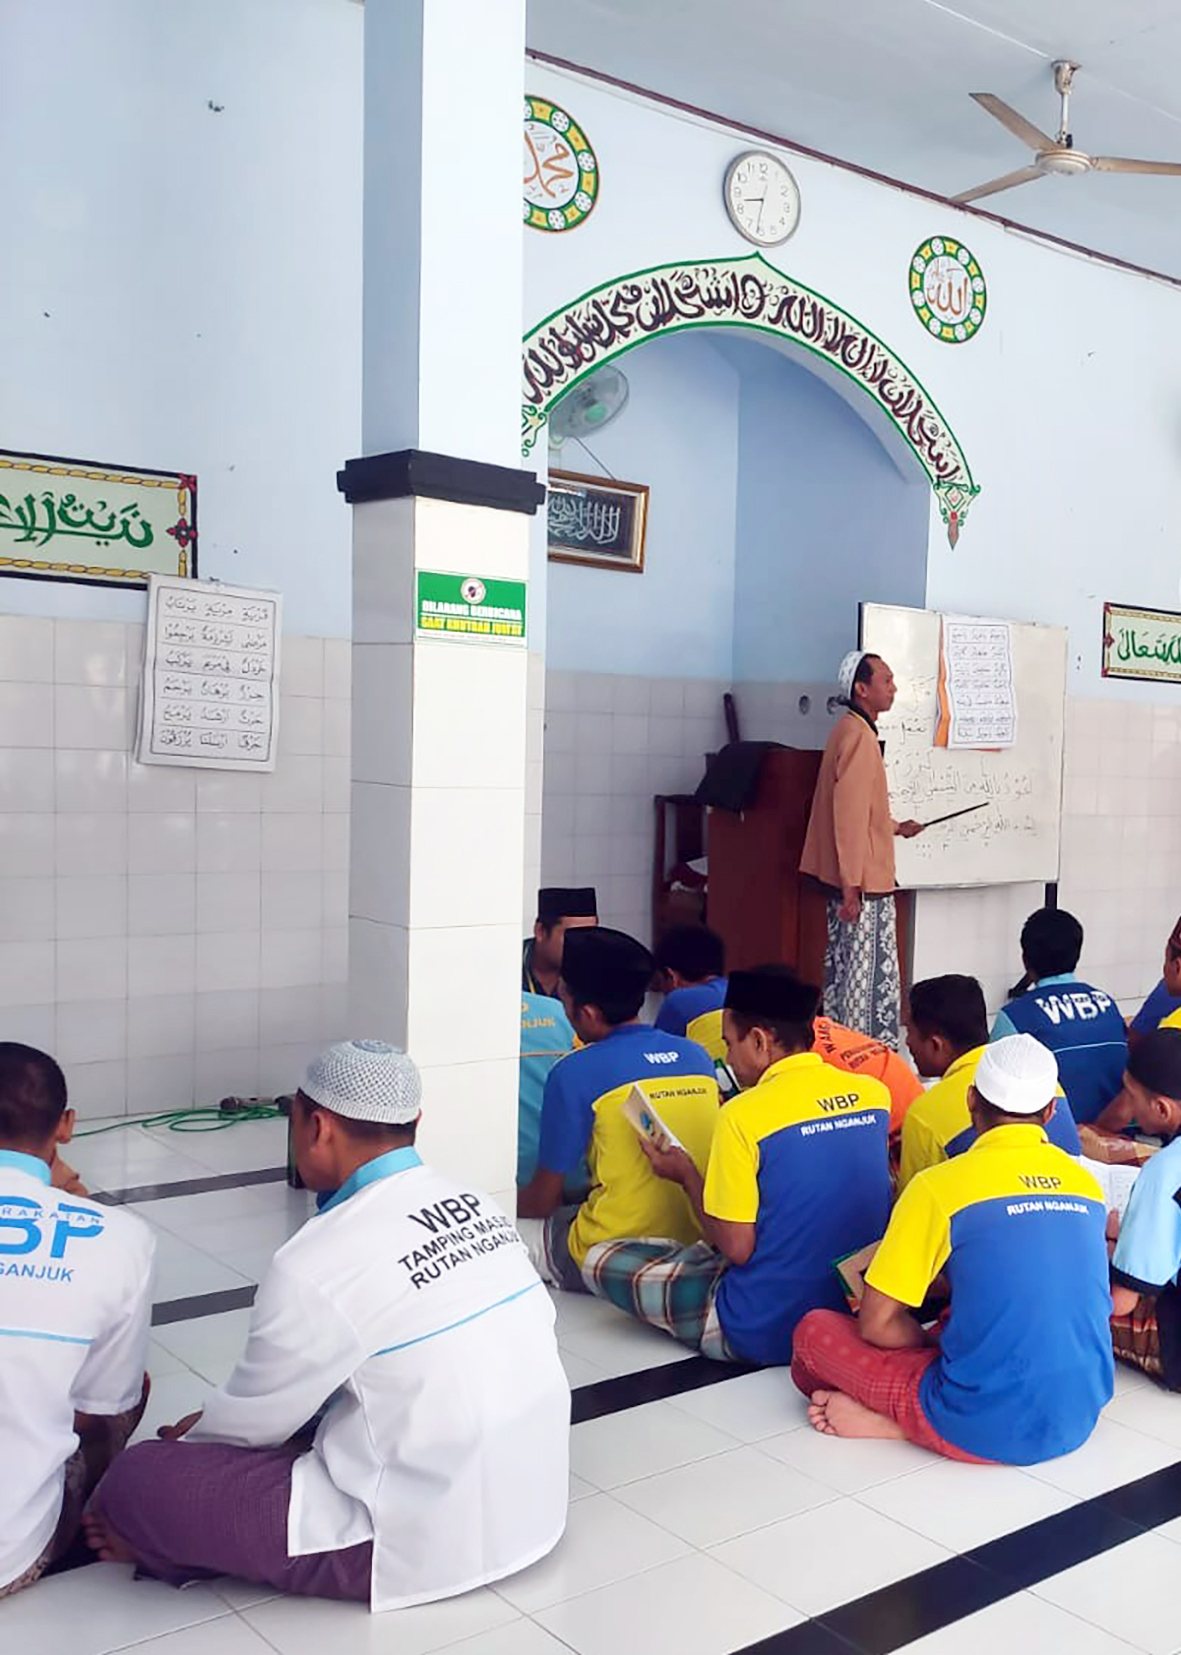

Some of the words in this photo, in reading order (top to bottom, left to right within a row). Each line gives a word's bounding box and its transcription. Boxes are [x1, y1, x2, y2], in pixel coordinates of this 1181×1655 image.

[759, 162, 769, 174] 12
[737, 172, 748, 184] 10
[780, 185, 789, 198] 2
[736, 203, 745, 215] 8
[783, 202, 791, 214] 3
[746, 217, 753, 229] 7
[1035, 990, 1112, 1025] WBP
[643, 1051, 680, 1064] WBP
[816, 1093, 860, 1112] WBP
[800, 1121, 834, 1137] RUTAN
[834, 1114, 876, 1129] NGANJUK
[1018, 1175, 1062, 1190] WBP
[2, 1206, 100, 1224] RAKATAN
[407, 1193, 482, 1234] WBP
[1006, 1201, 1044, 1216] RUTAN
[0, 1195, 105, 1259] BP
[398, 1226, 475, 1271] TAMPING
[0, 1262, 76, 1282] GANJUK
[410, 1247, 473, 1290] RUTAN
